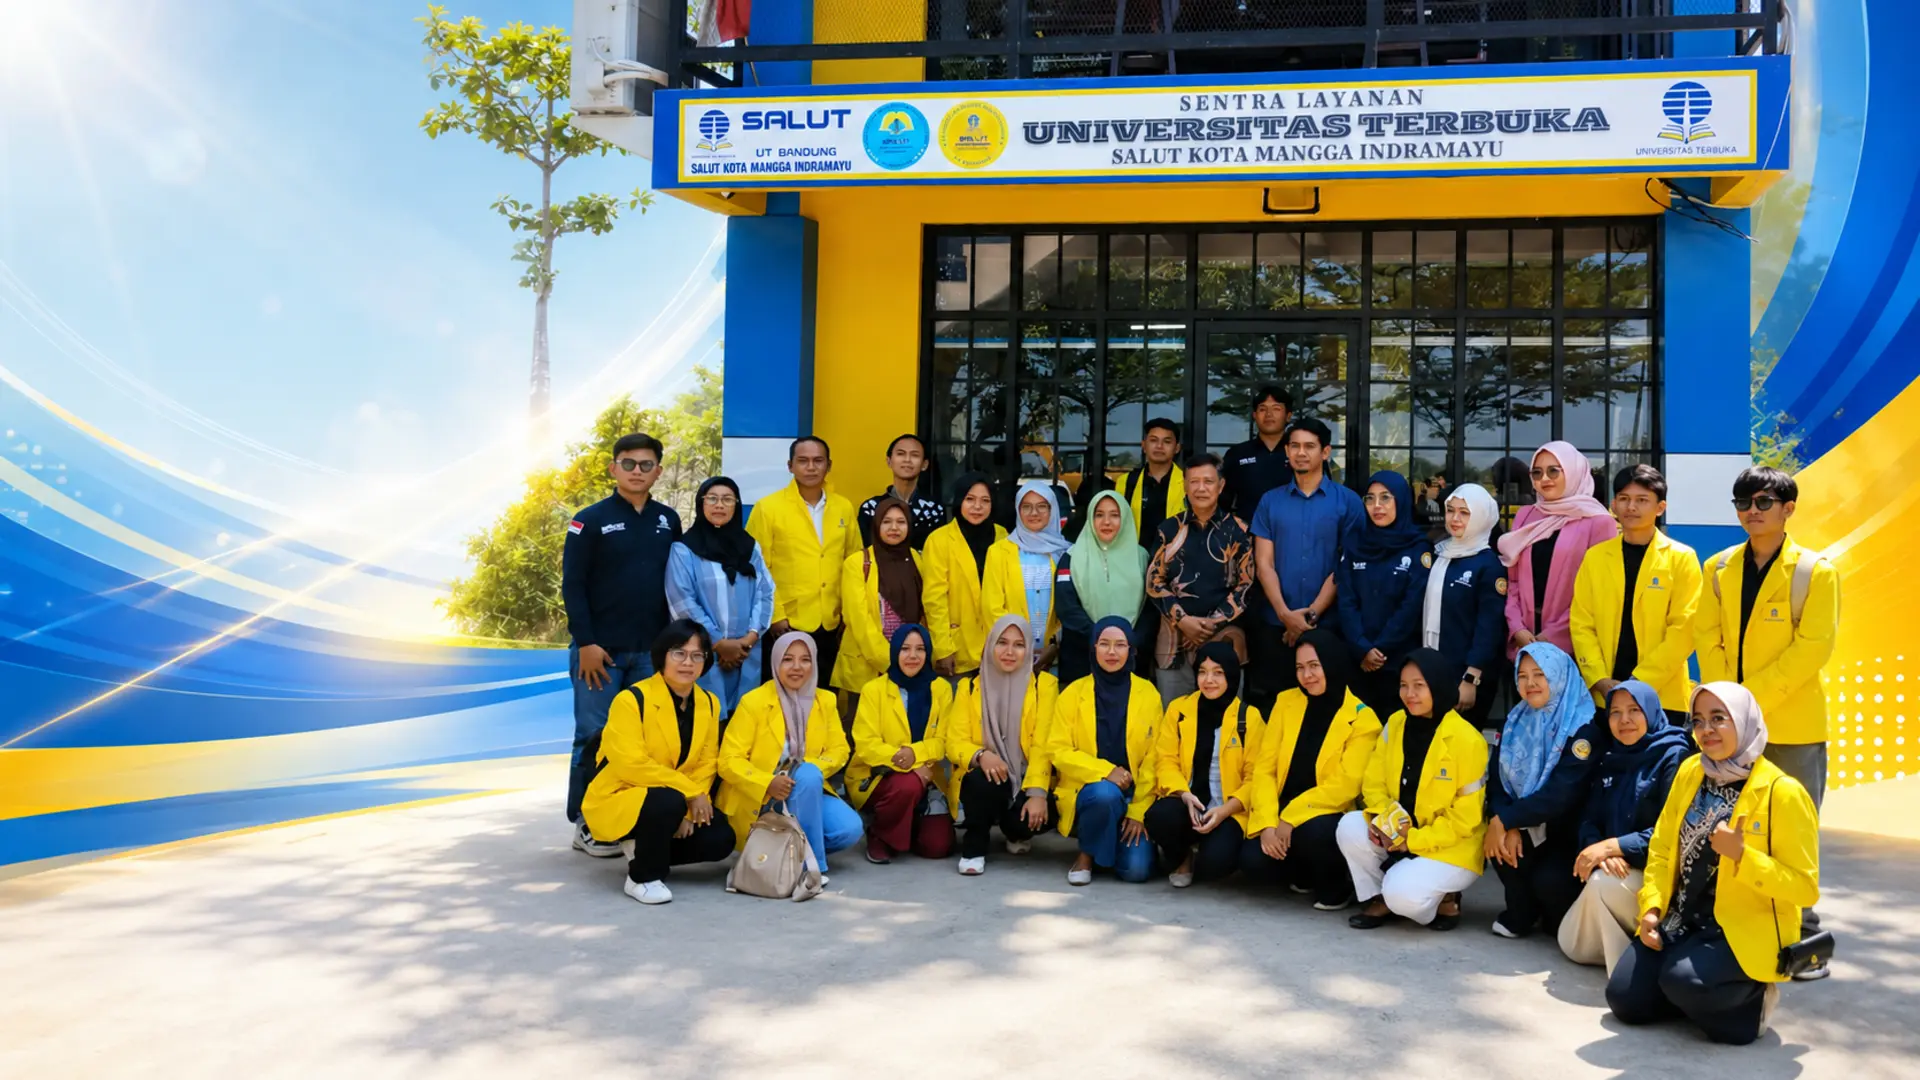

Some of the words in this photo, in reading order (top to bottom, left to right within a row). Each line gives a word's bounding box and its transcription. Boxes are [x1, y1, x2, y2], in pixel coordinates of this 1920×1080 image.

[1180, 94, 1285, 111] SENTRA
[1297, 89, 1424, 108] LAYANAN
[742, 110, 851, 130] SALUT
[1023, 115, 1351, 144] UNIVERSITAS
[1359, 107, 1610, 137] TERBUKA
[756, 148, 772, 157] UT
[778, 147, 837, 157] BANDUNG
[1112, 149, 1183, 165] SALUT
[1188, 147, 1249, 163] KOTA
[1255, 145, 1352, 162] MANGGA
[1360, 141, 1504, 160] INDRAMAYU
[1636, 147, 1693, 156] UNIVERSITAS
[1696, 145, 1737, 154] TERBUKA
[691, 163, 720, 174] SALUT
[723, 162, 747, 173] KOTA
[750, 161, 792, 172] MANGGA
[794, 160, 852, 172] INDRAMAYU
